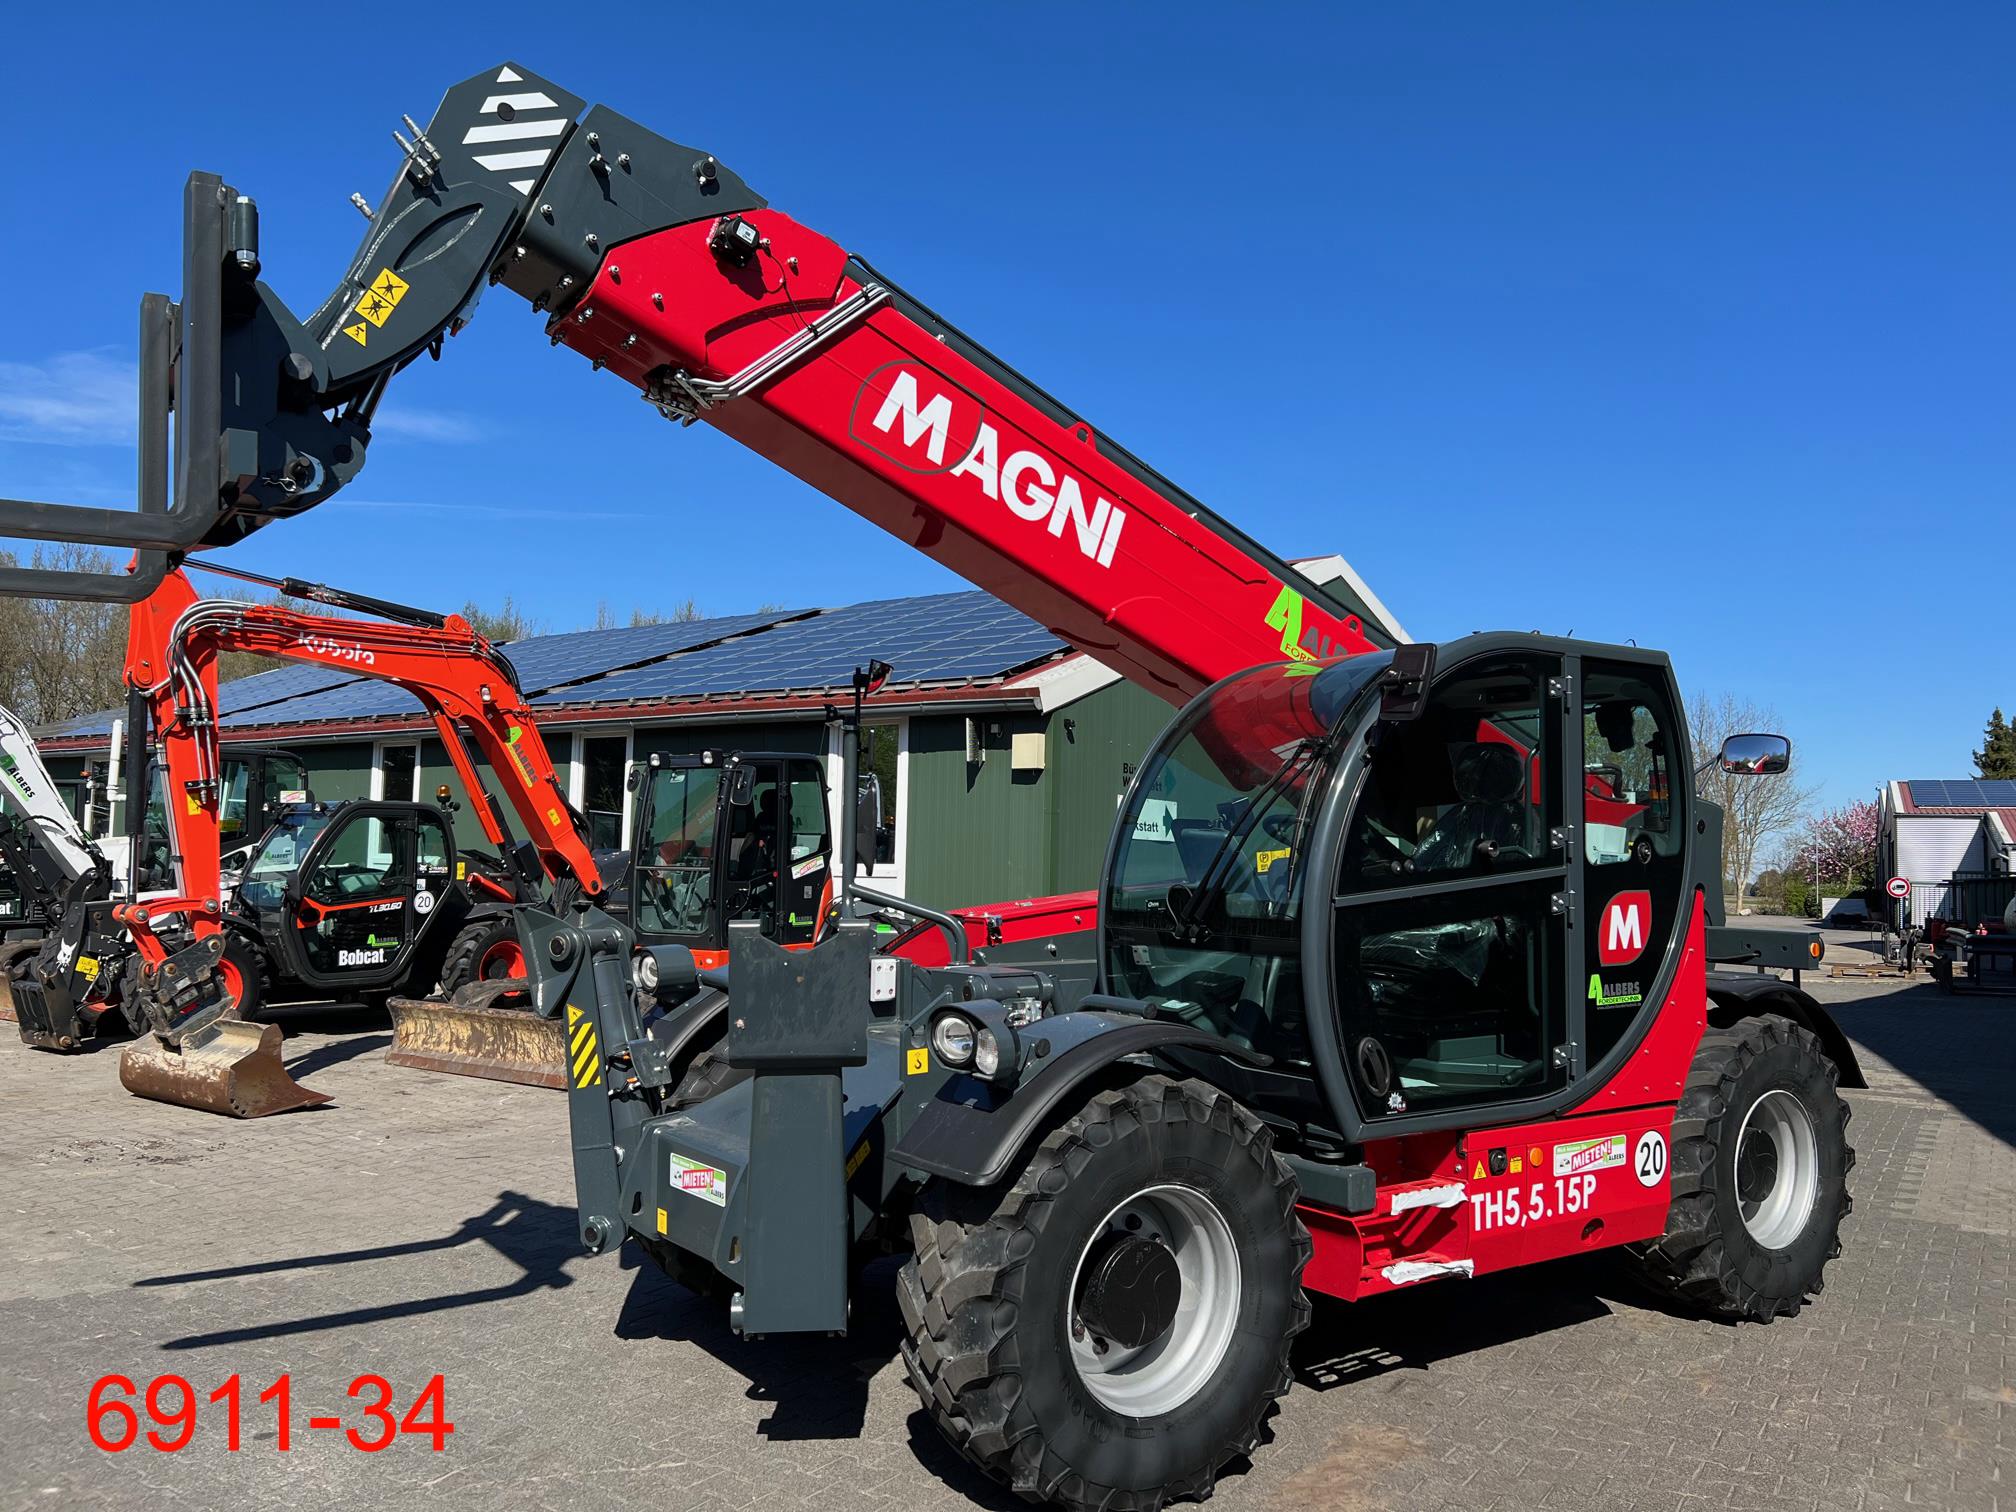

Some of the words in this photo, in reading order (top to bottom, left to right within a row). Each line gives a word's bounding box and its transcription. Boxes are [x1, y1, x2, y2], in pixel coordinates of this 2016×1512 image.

[872, 370, 1126, 569] MAGNI
[298, 629, 375, 665] Kubota
[8, 767, 35, 798] ALBERS
[417, 895, 431, 908] 20
[1608, 904, 1642, 951] M
[1603, 982, 1640, 997] ALBERS
[1572, 1139, 1612, 1170] MIETEN!
[1640, 1140, 1663, 1177] 20
[1471, 1174, 1597, 1231] TH5,5.15P
